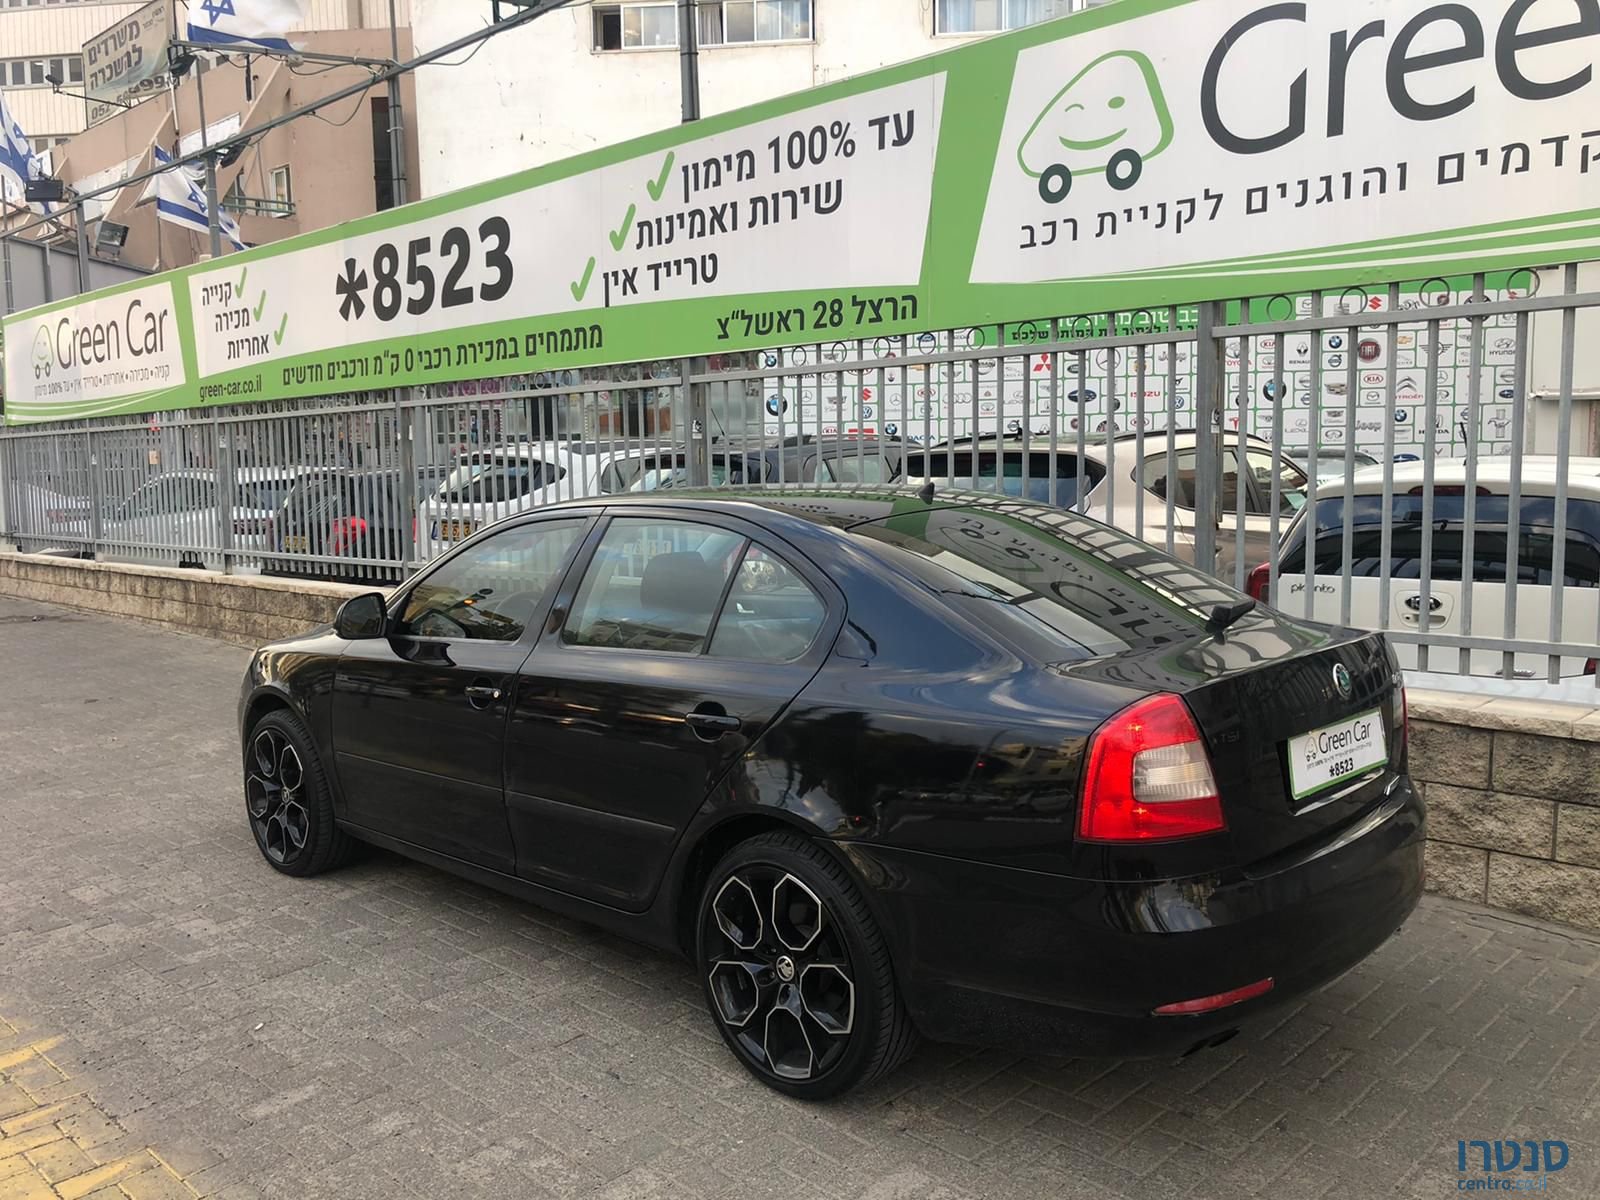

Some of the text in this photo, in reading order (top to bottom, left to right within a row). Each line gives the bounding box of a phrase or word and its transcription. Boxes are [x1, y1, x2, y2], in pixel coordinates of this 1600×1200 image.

[87, 19, 140, 66] משרדים
[89, 43, 143, 91] להשכרה
[1200, 0, 1600, 155] Gree
[681, 108, 915, 204] עד 100% מימון
[1246, 161, 1408, 216] והוגנים
[635, 178, 843, 251] שירות ואמינות
[1095, 188, 1224, 239] לקניית
[1019, 214, 1079, 250] רכב
[202, 281, 232, 307] קנייה
[602, 252, 719, 308] טרייד אין
[215, 306, 250, 333] מכירה
[813, 298, 844, 330] 28
[851, 293, 918, 325] הרצל
[56, 299, 168, 370] Green Car
[226, 333, 270, 361] אחריות
[456, 336, 520, 366] במכירת
[525, 323, 603, 357] מתמחים
[282, 363, 324, 386] חדשים
[327, 357, 369, 381] ורכבים
[404, 348, 414, 372] 0
[417, 348, 450, 371] רכבי
[200, 374, 262, 403] green-car.co.il
[1318, 720, 1371, 754] Green Car
